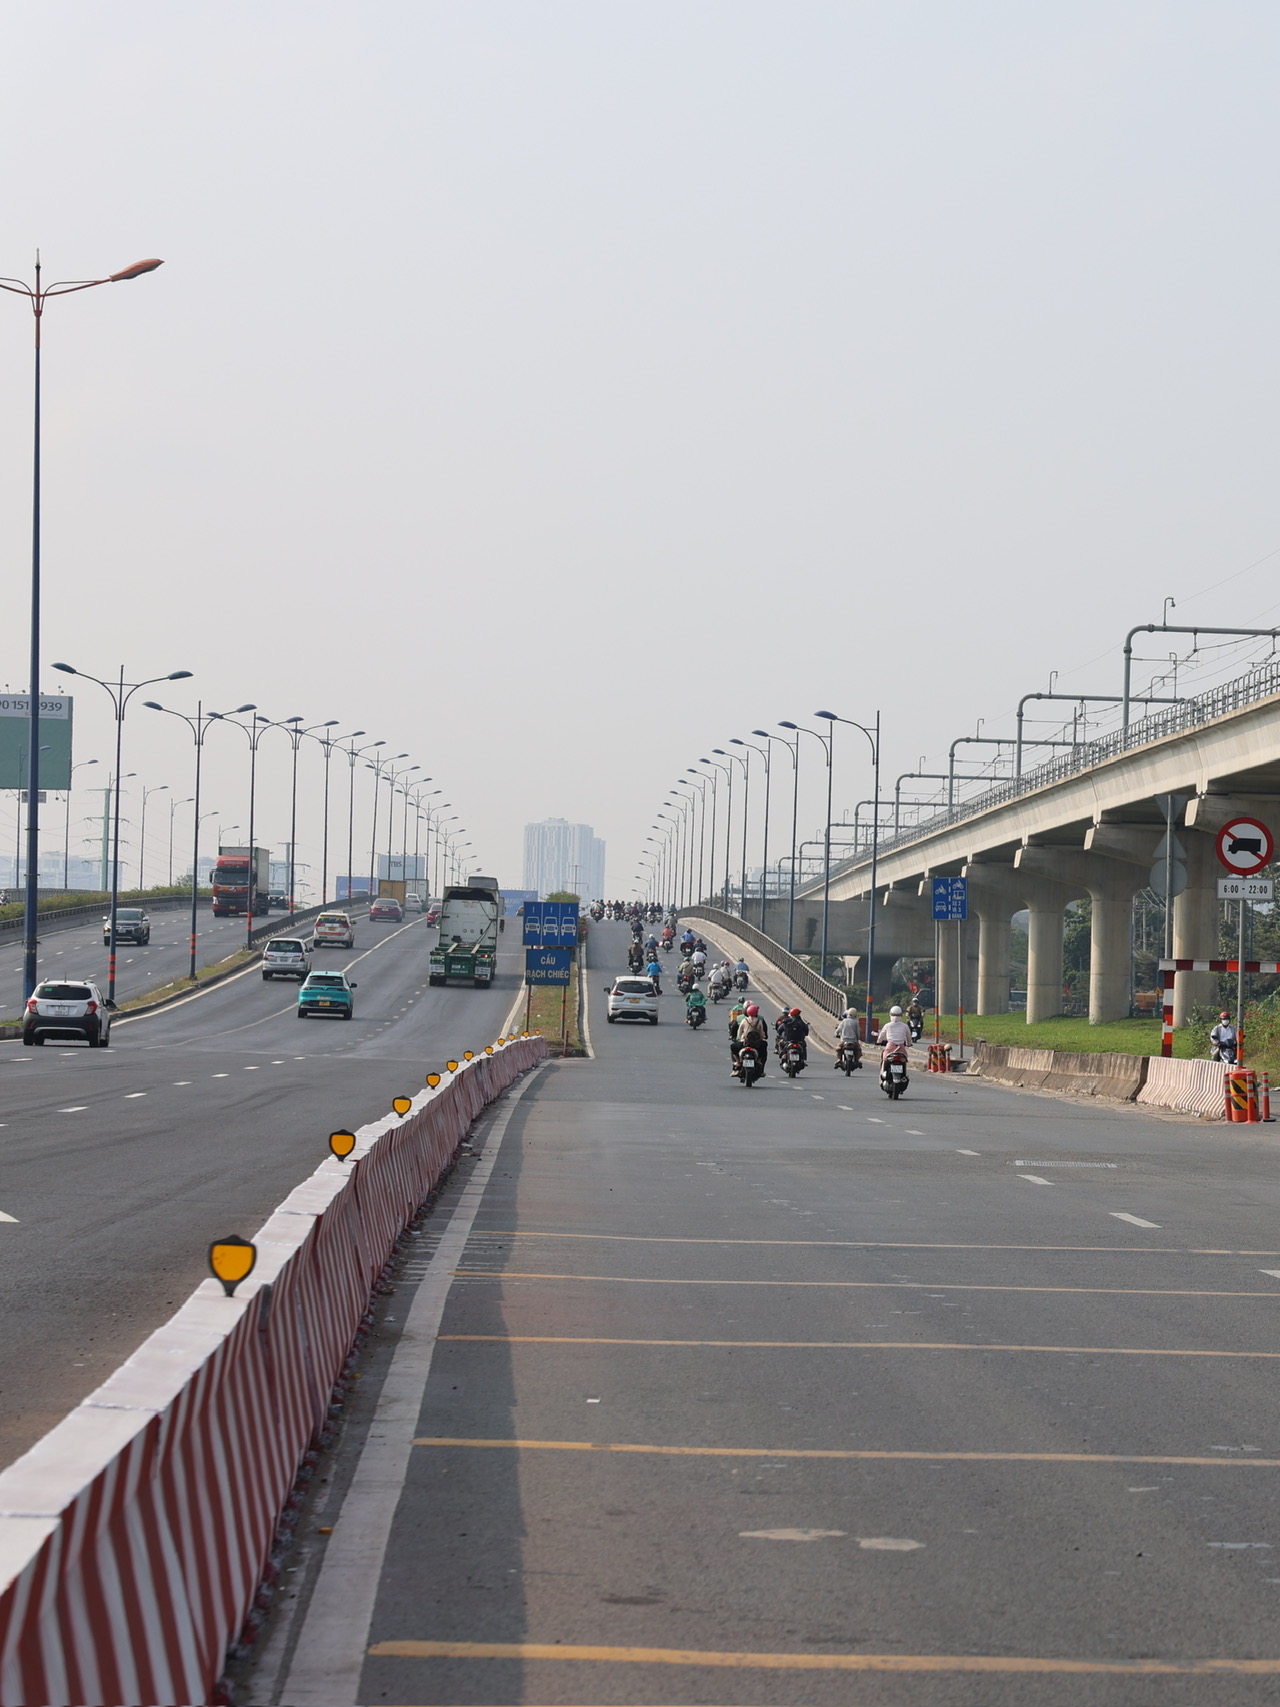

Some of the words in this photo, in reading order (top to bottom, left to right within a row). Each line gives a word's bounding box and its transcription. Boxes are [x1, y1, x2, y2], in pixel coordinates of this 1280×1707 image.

[11, 700, 29, 710] 151
[1223, 884, 1239, 893] 6:00
[1249, 885, 1268, 894] 22:00
[526, 970, 546, 981] RẠCH
[547, 967, 570, 979] CHIẾC
